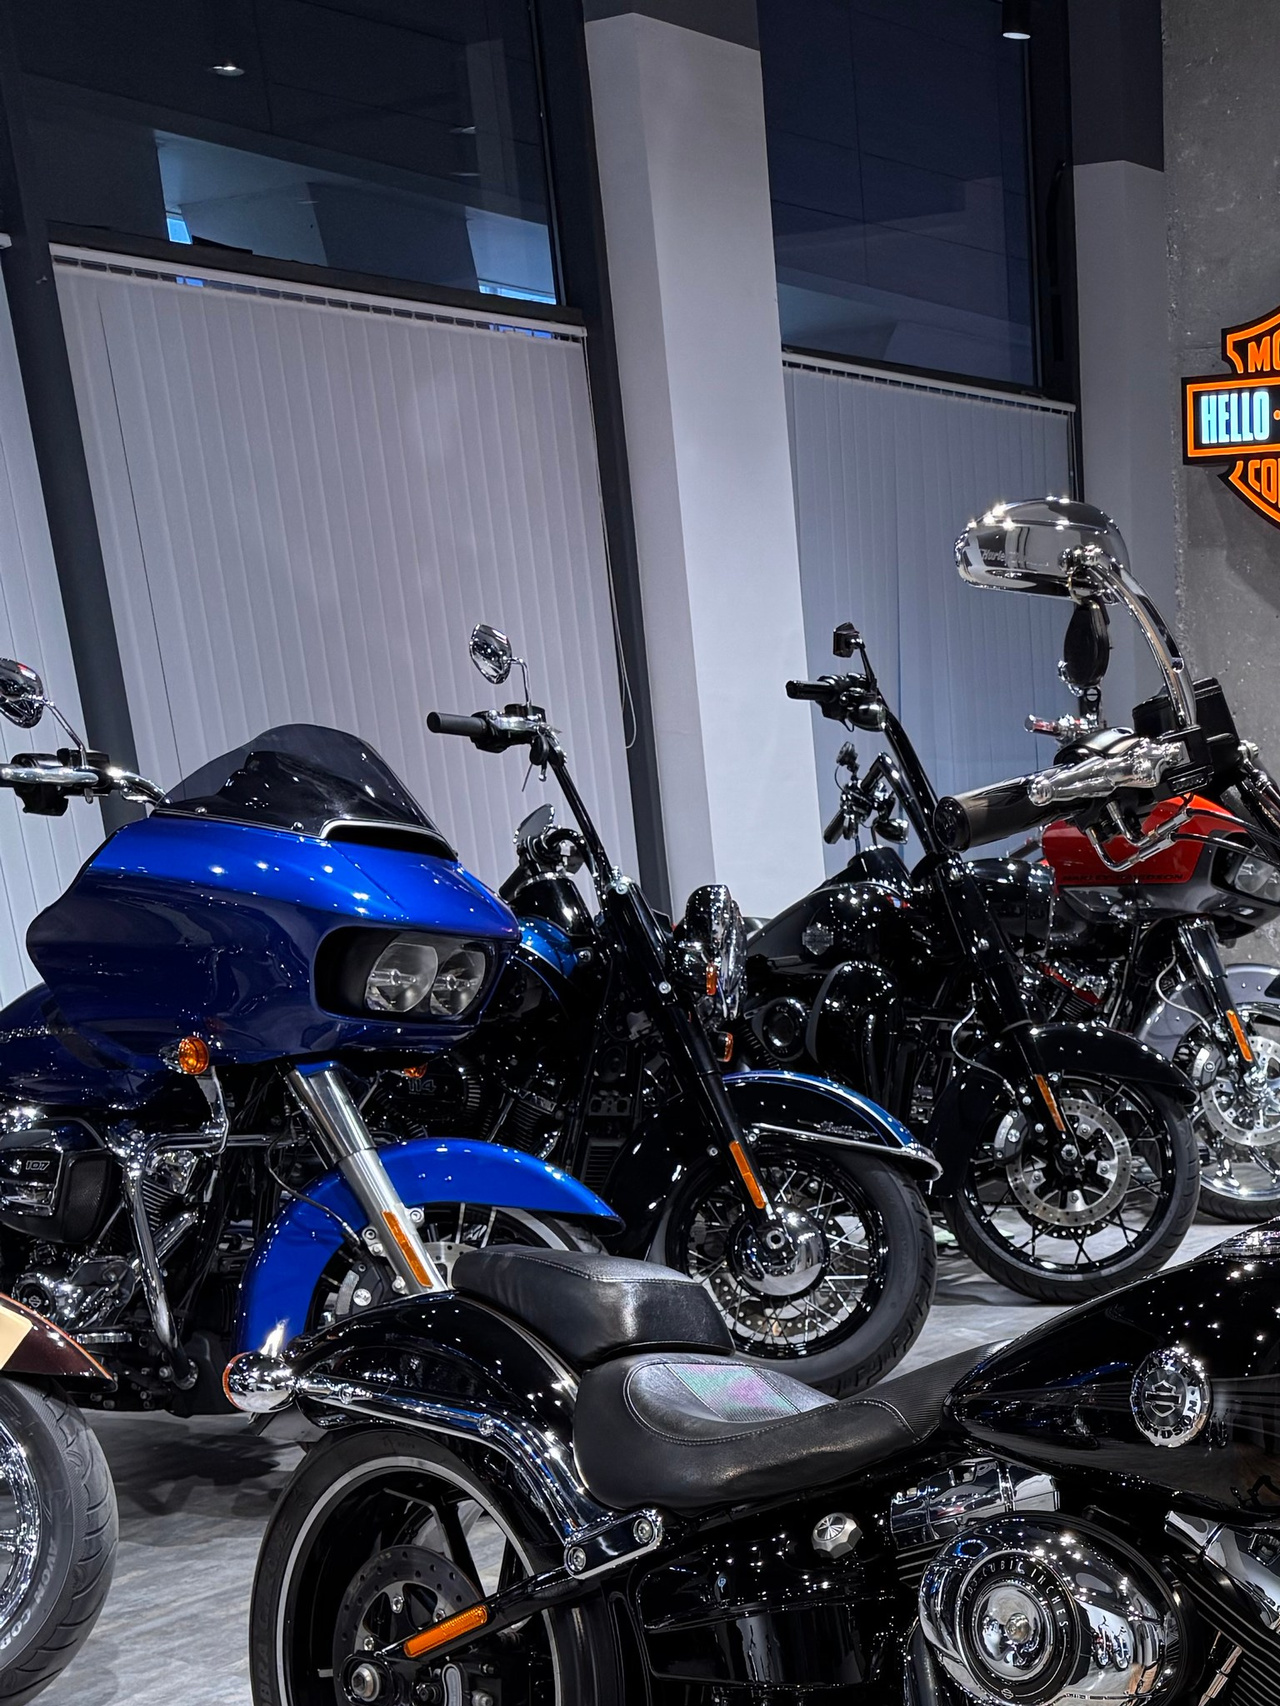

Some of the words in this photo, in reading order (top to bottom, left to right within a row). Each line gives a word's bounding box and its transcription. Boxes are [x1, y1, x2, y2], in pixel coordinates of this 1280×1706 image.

[1201, 390, 1270, 444] HELLO
[25, 1160, 51, 1171] 107
[34, 1537, 58, 1604] AVON
[982, 1559, 1026, 1577] CUBIC
[1031, 1568, 1069, 1628] INCHES
